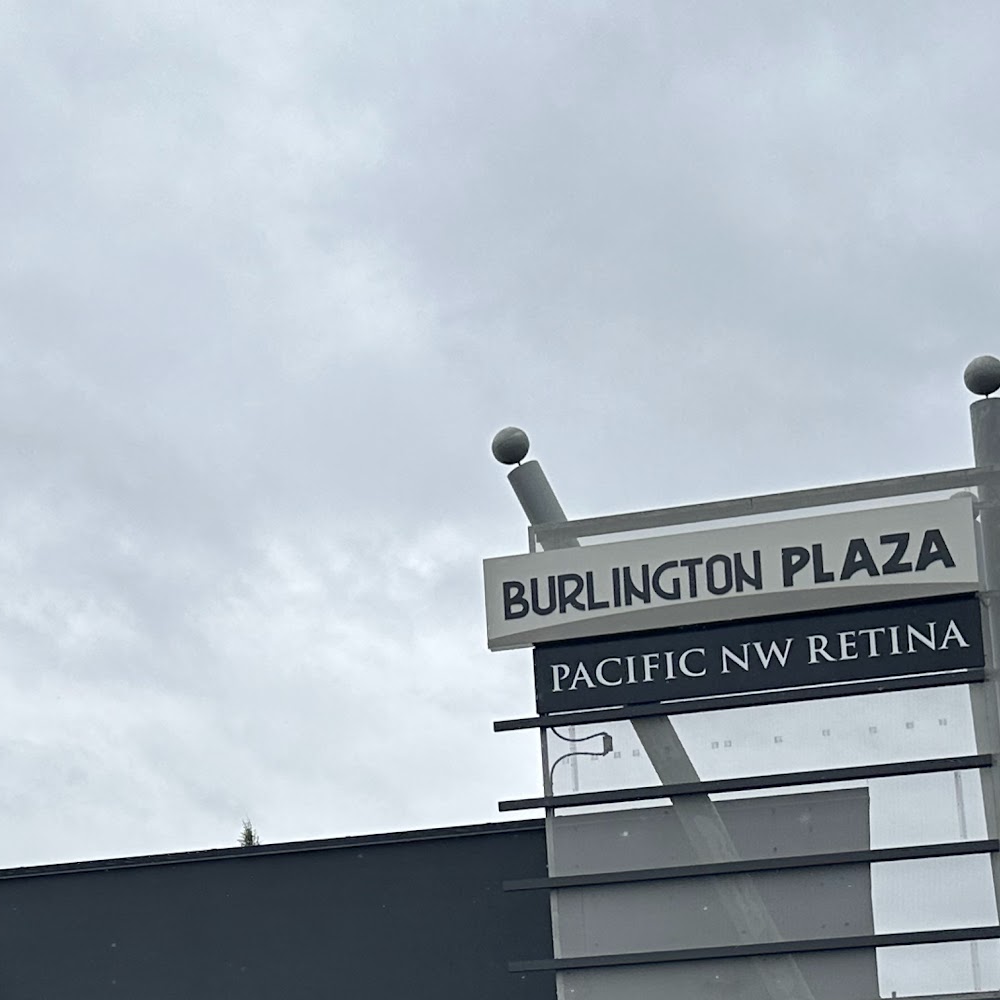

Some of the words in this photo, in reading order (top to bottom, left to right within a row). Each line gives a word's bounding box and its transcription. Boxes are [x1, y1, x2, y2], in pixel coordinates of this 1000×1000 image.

[503, 550, 763, 620] BURLINGTON
[782, 528, 956, 587] PLAZA
[551, 648, 707, 692] PACIFIC
[720, 638, 795, 674] NW
[807, 619, 970, 665] RETINA
